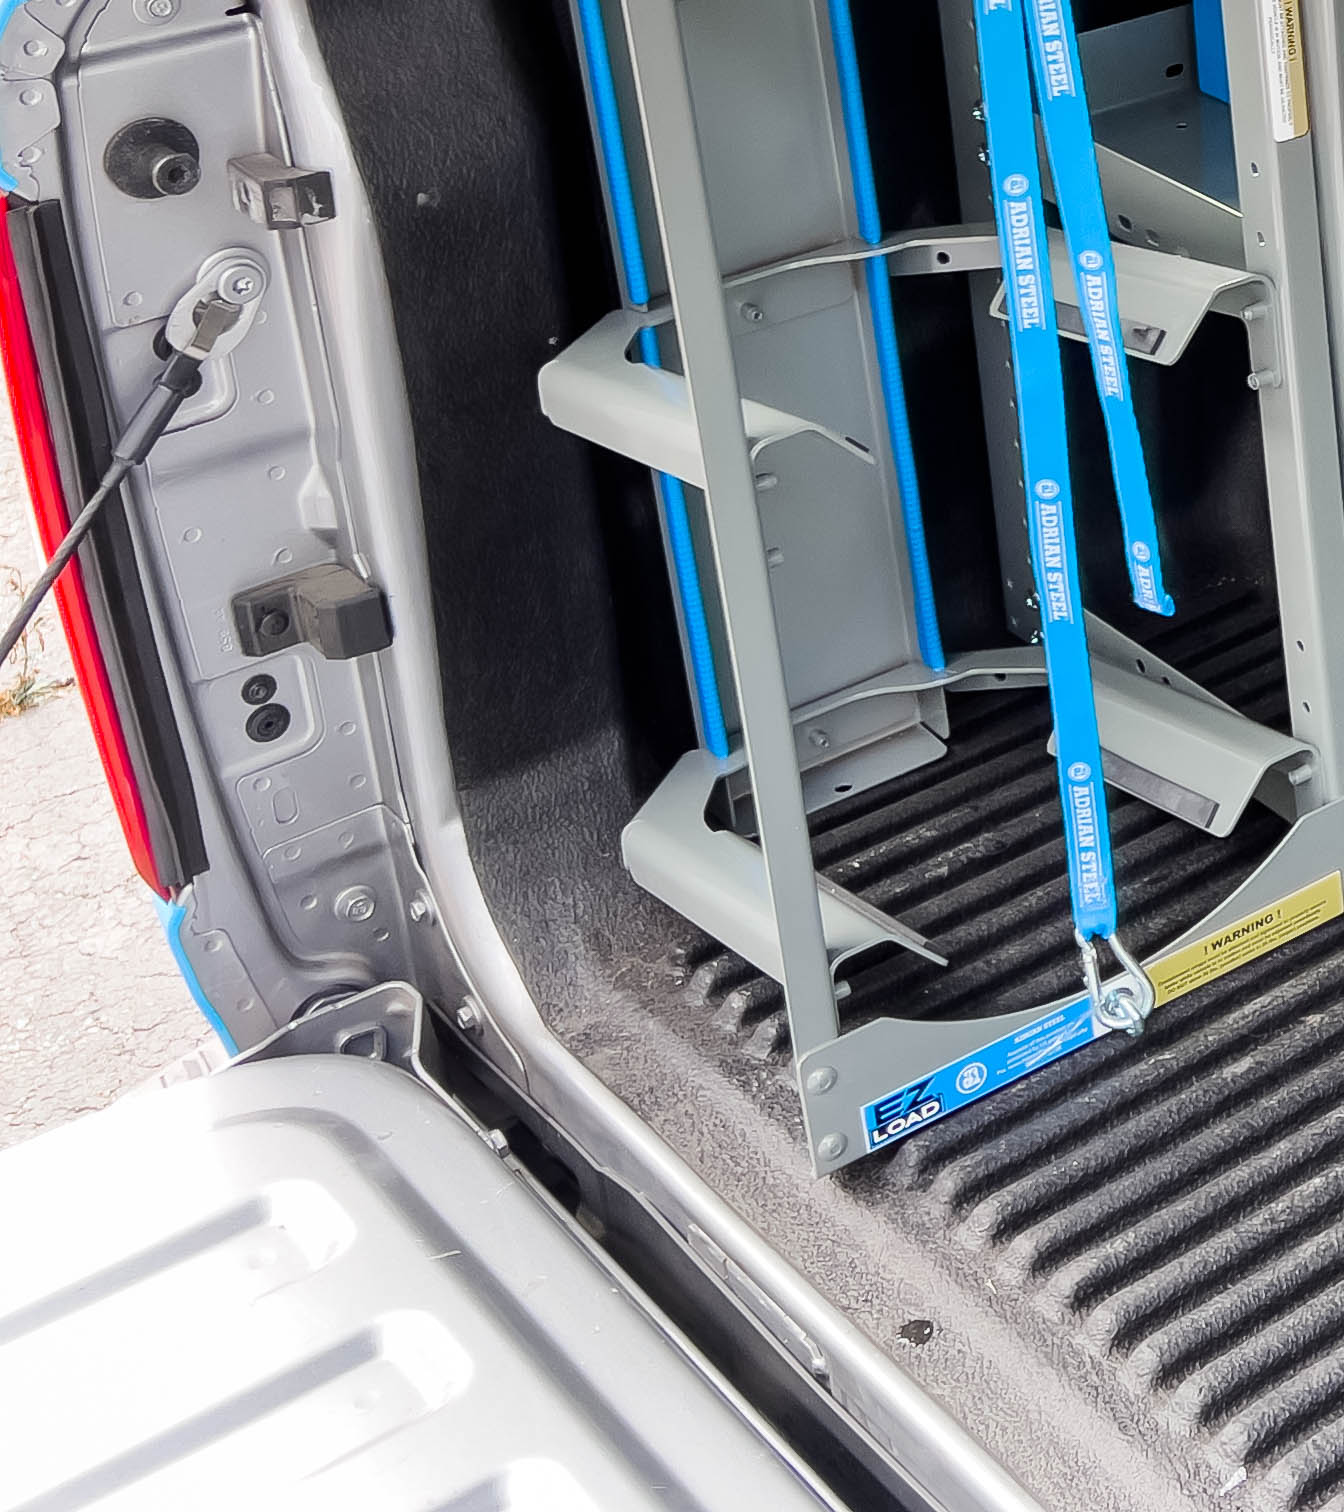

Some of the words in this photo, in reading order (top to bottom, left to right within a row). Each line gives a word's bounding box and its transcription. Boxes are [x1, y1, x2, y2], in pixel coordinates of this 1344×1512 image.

[1285, 6, 1296, 56] WARNING
[1044, 40, 1069, 97] STEEL
[1008, 201, 1034, 271] ADRIAN
[1018, 274, 1040, 329] STEEL
[1085, 274, 1111, 340] ADRIAN
[1099, 342, 1119, 397] STEEL
[1039, 503, 1062, 569] ADRIAN
[1047, 572, 1069, 621] STEEL
[1072, 785, 1095, 848] ADRIAN
[1080, 851, 1101, 904] STEEL
[1211, 913, 1274, 951] WARNING
[872, 1101, 940, 1144] LOAD
[874, 1076, 936, 1126] EZ
